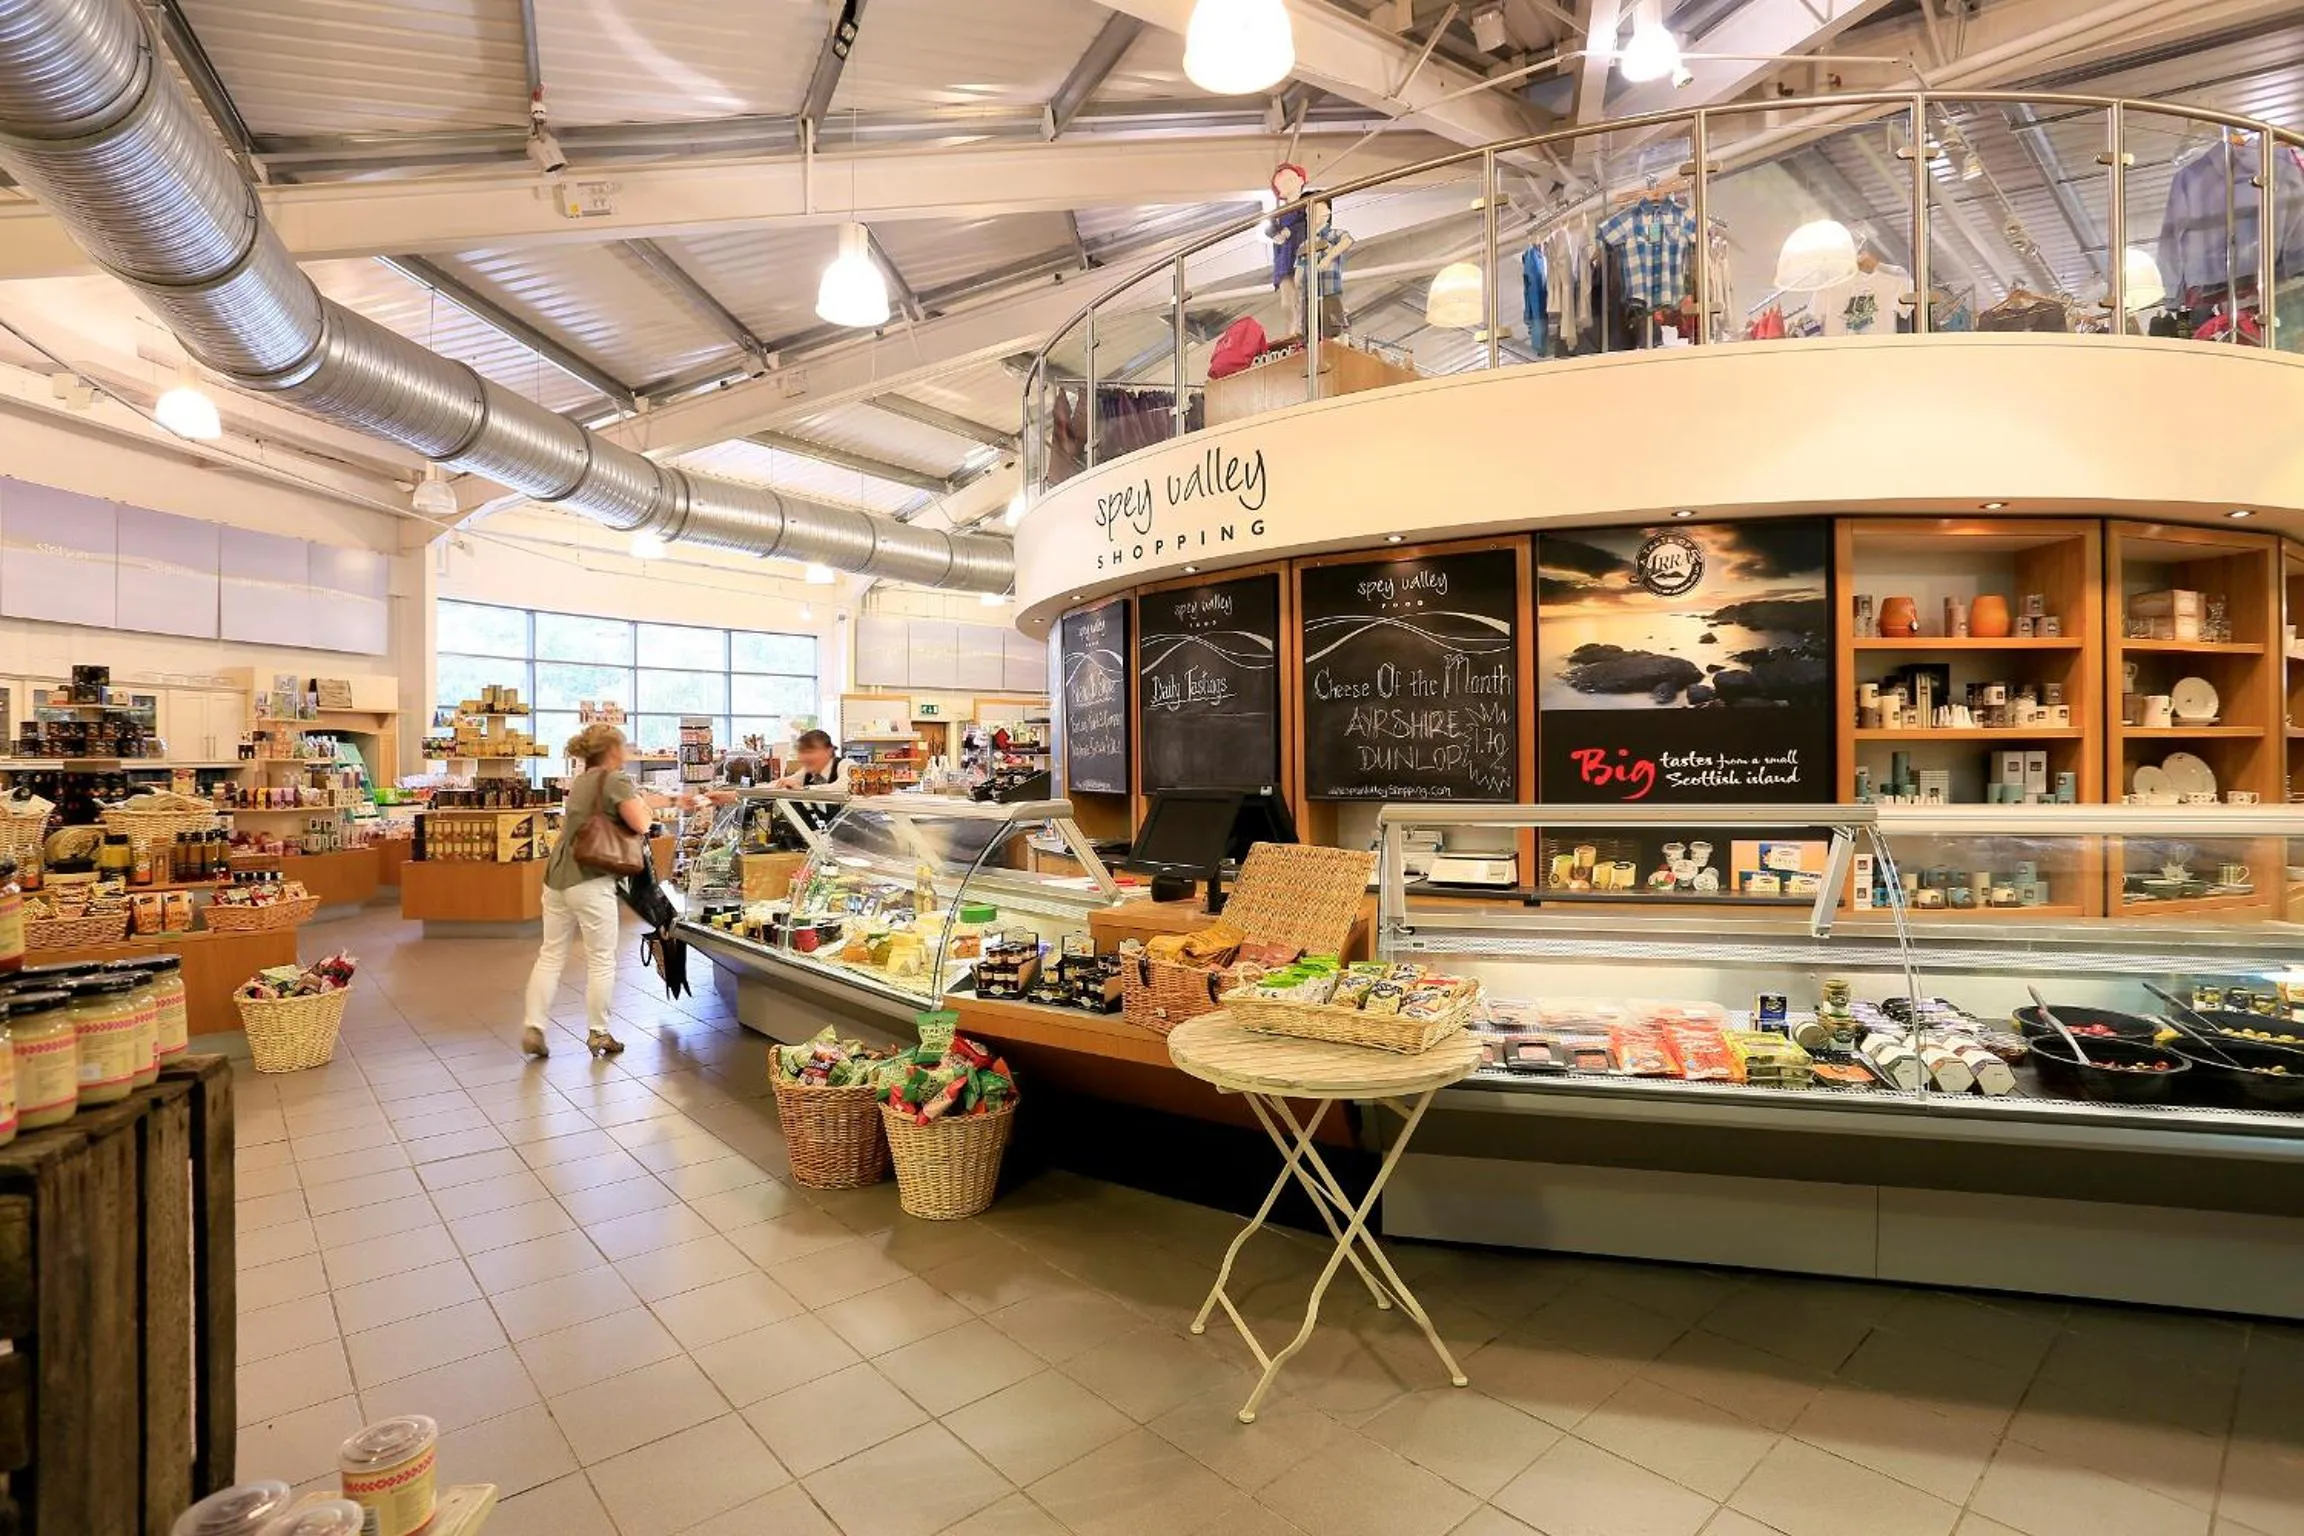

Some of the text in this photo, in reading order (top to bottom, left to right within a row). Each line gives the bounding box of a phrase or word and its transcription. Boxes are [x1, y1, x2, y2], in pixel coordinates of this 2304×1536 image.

[1095, 446, 1267, 542] spey valley
[1097, 519, 1265, 570] SHOPPING
[1357, 570, 1448, 601] spey valley
[1443, 653, 1511, 699] Month
[1344, 706, 1462, 739] AYRSHIRE
[1358, 745, 1463, 772] DUNLOP
[1570, 748, 1656, 800] Big
[1660, 749, 1798, 769] tastes from a small
[1665, 767, 1800, 788] Scottish island
